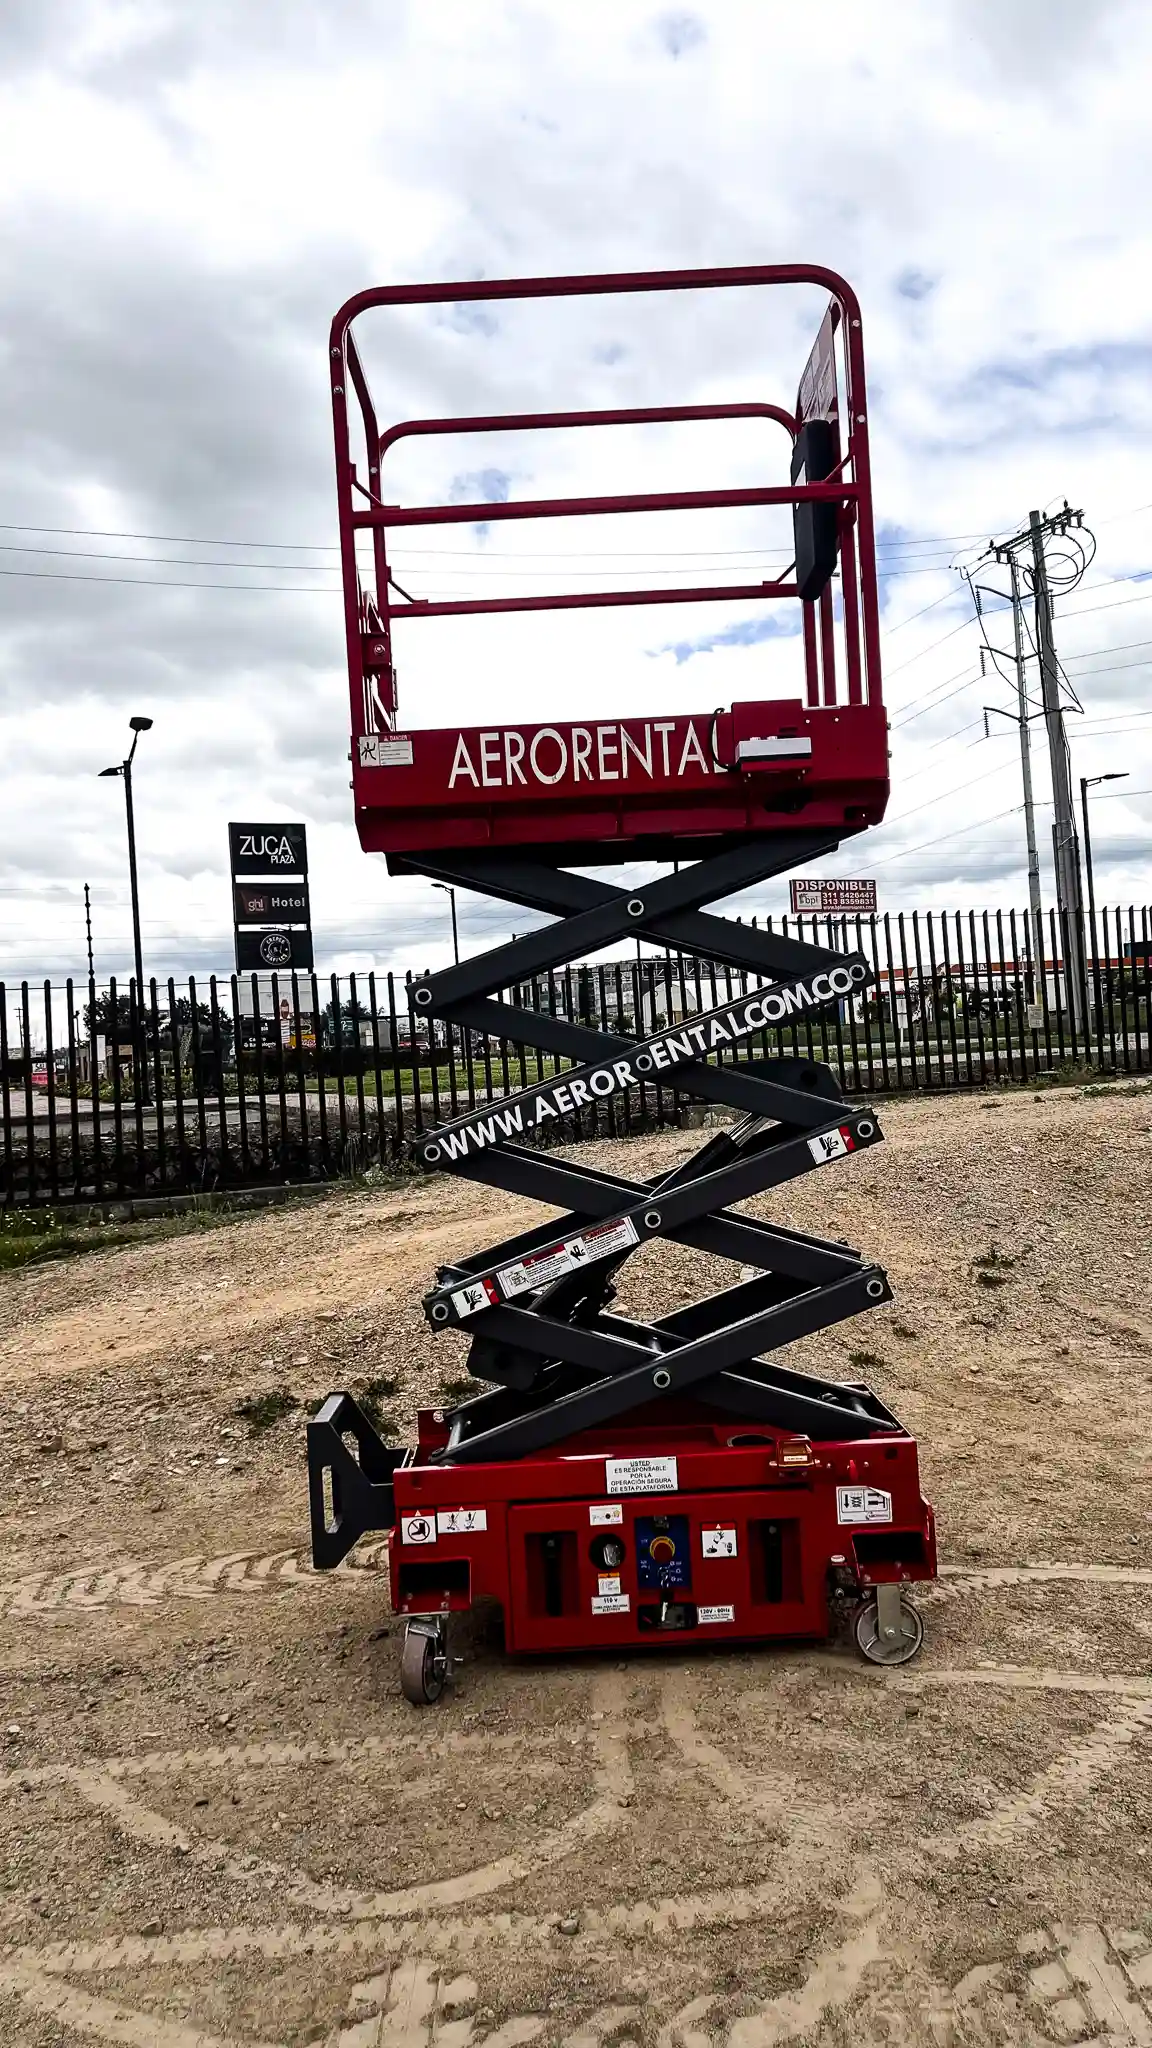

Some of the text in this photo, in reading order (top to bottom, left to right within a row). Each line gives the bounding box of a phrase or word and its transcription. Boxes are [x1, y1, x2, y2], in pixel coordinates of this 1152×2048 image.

[239, 835, 293, 855] ZUCA
[270, 855, 295, 864] PLAZA
[795, 881, 874, 891] DISPONIBLE
[271, 897, 305, 907] Hotel
